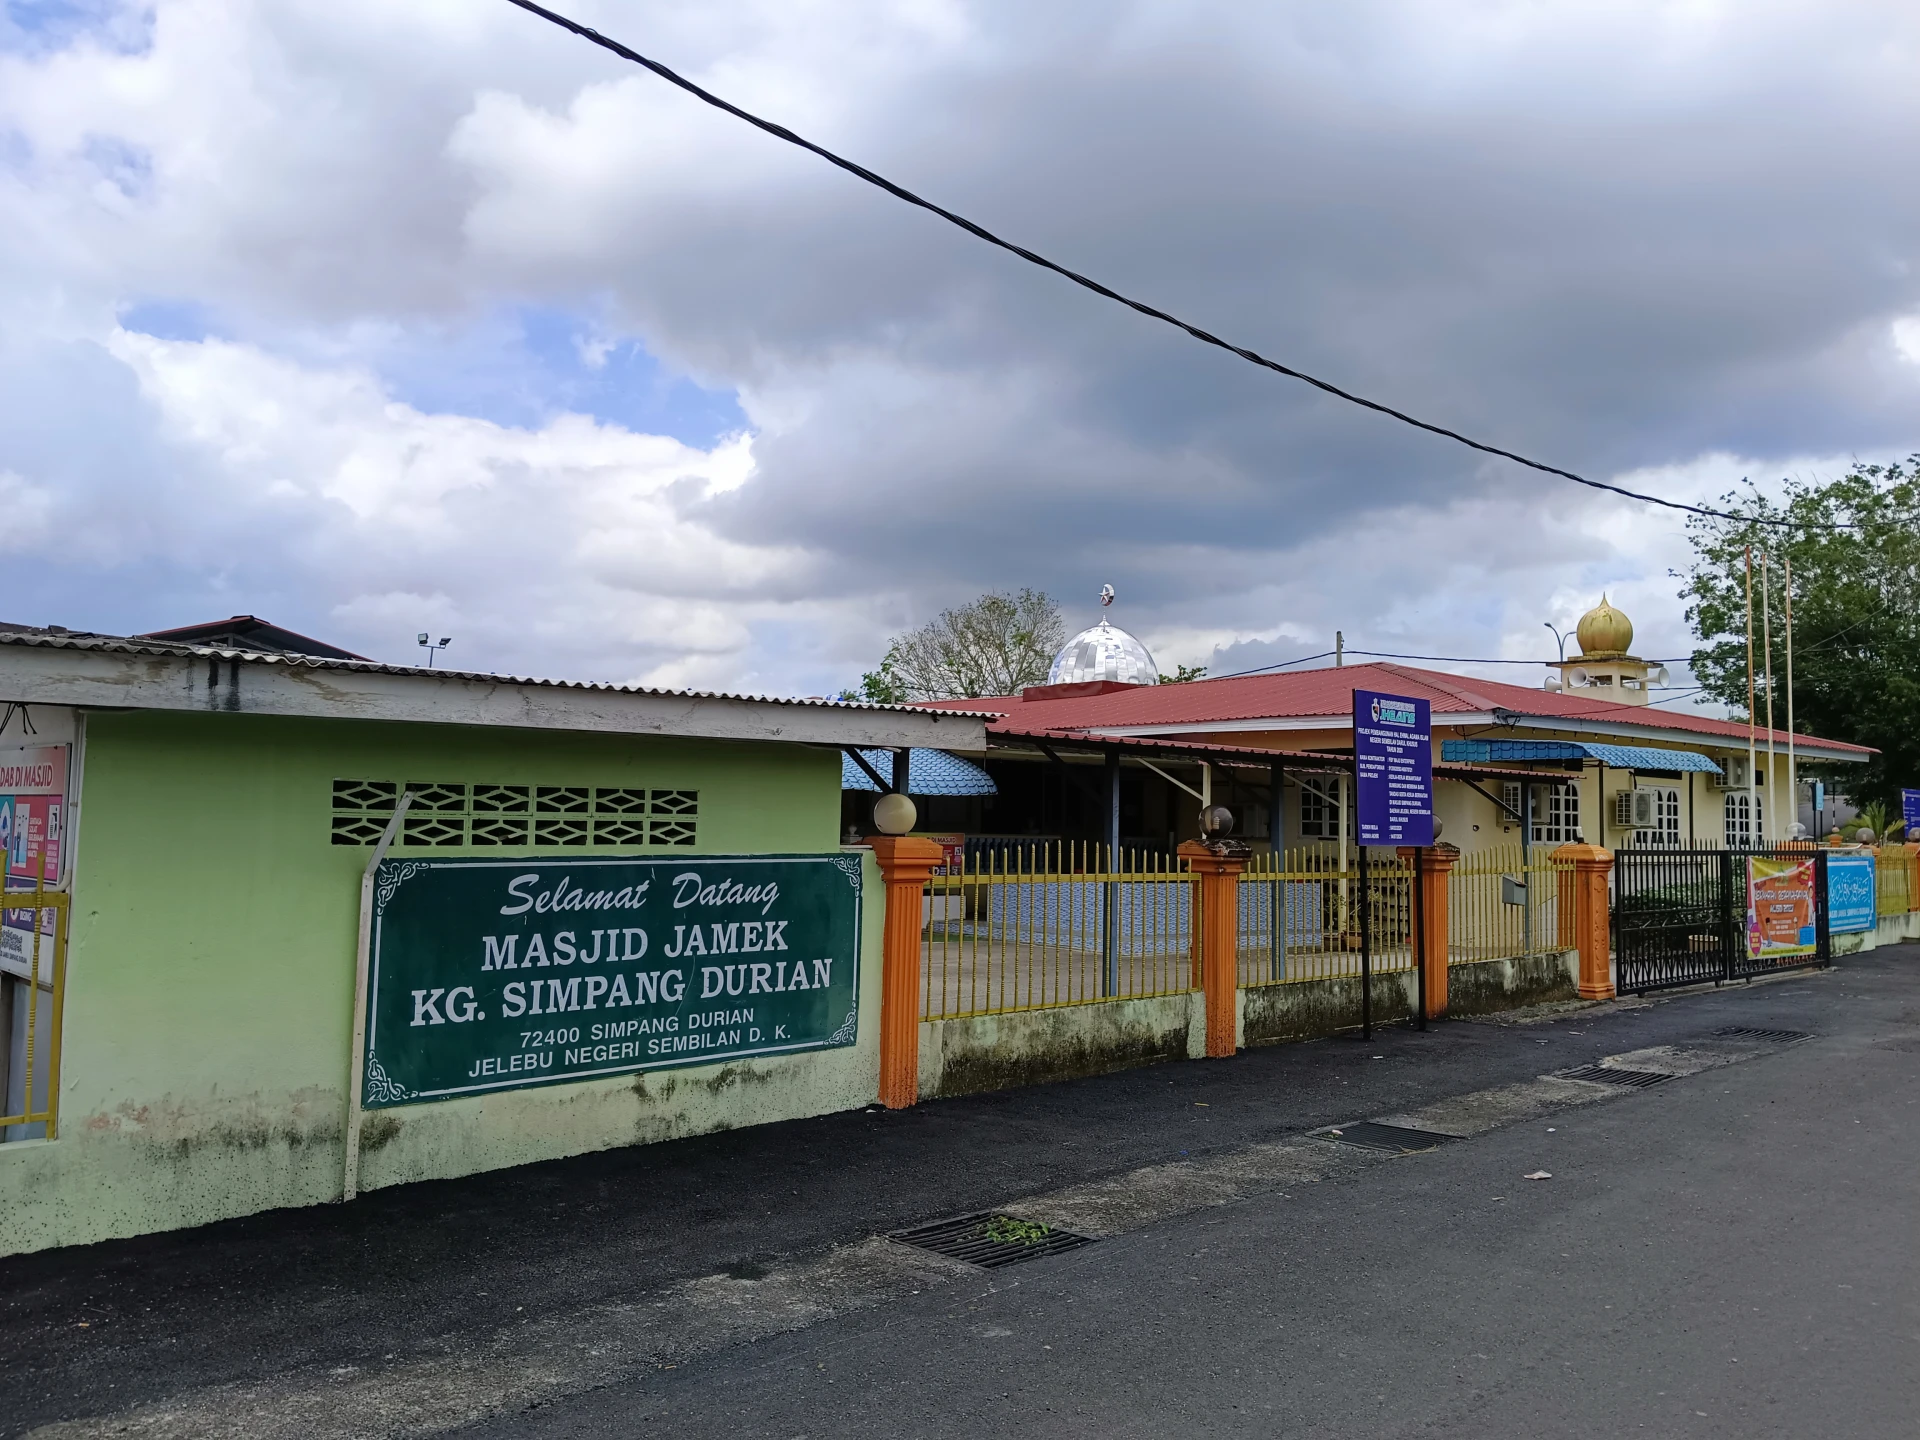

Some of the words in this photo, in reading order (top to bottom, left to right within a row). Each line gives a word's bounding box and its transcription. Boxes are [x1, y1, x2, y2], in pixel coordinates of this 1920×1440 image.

[15, 766, 23, 787] DI
[24, 764, 53, 787] MASJID
[500, 874, 650, 916] Selamat
[672, 872, 780, 915] Datang
[481, 928, 648, 971] MASJID
[664, 920, 788, 958] JAMEK
[410, 986, 486, 1026] KG.
[502, 968, 685, 1018] SIMPANG
[700, 958, 833, 999] DURIAN
[468, 1052, 553, 1077] JELEBU
[564, 1040, 639, 1065] NEGERI
[647, 1029, 740, 1055] SEMBILAN
[749, 1027, 765, 1042] D.
[775, 1025, 791, 1040] K.
[520, 1027, 580, 1048] 72400
[591, 1016, 679, 1041] SIMPANG
[688, 1008, 754, 1029] DURIAN
